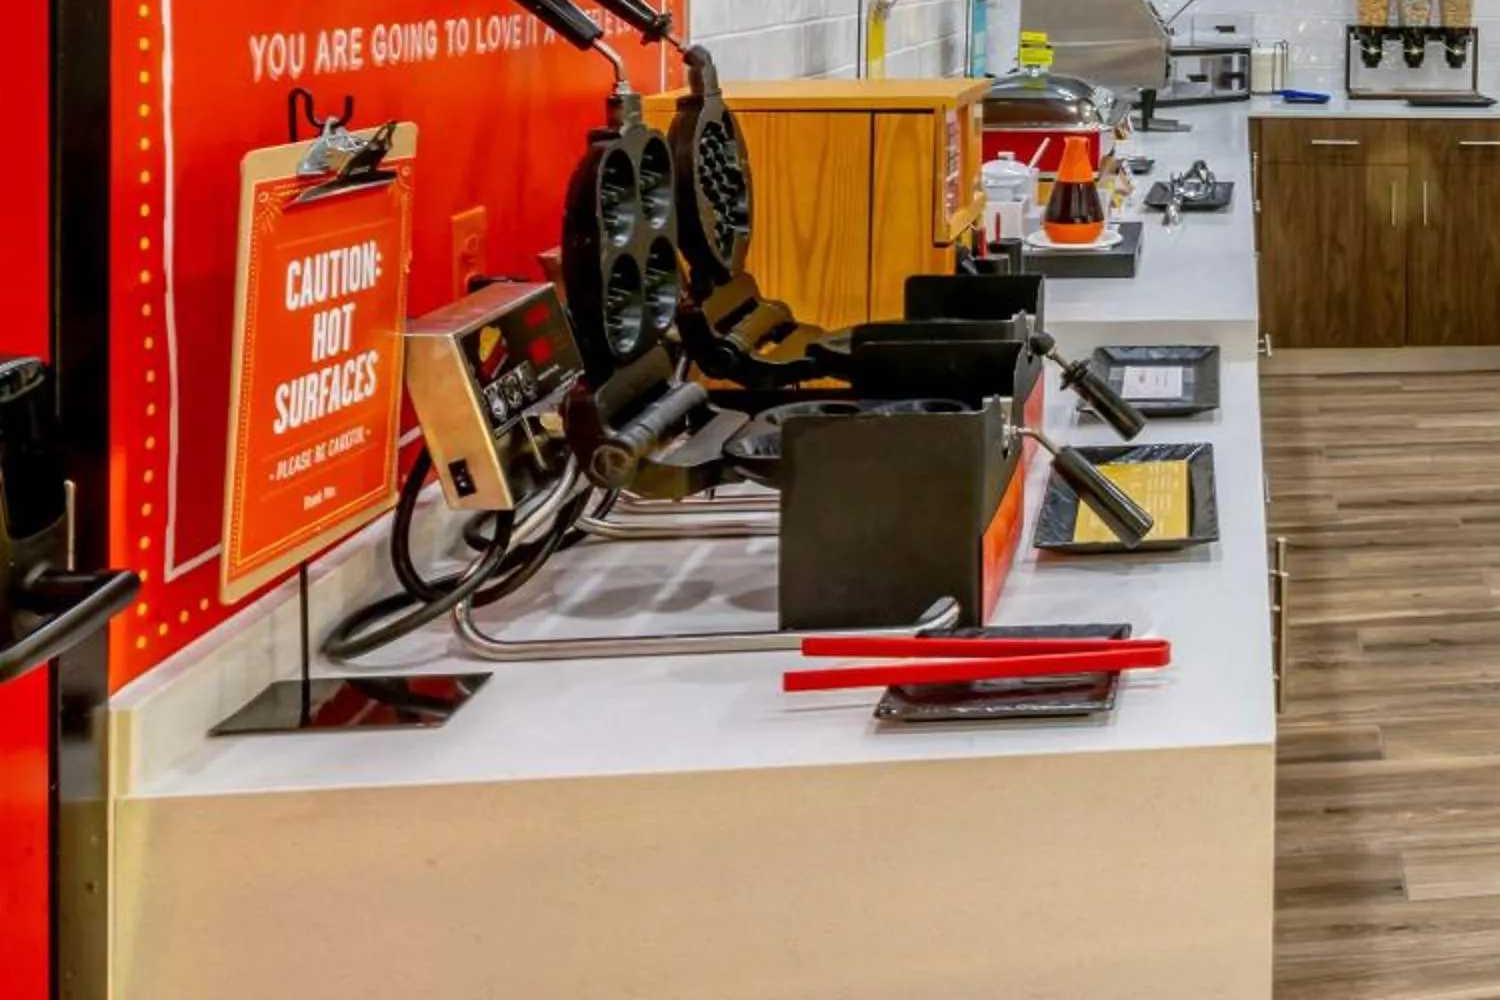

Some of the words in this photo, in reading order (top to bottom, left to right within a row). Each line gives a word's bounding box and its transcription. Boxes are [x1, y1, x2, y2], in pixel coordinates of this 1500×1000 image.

[250, 33, 307, 82] YOU
[313, 27, 364, 77] ARE
[370, 20, 438, 70] GOING
[444, 17, 470, 58] TO
[474, 14, 523, 55] LOVE
[286, 239, 382, 311] CAUTION:
[311, 302, 357, 362] HOT
[273, 349, 380, 435] SURFACES
